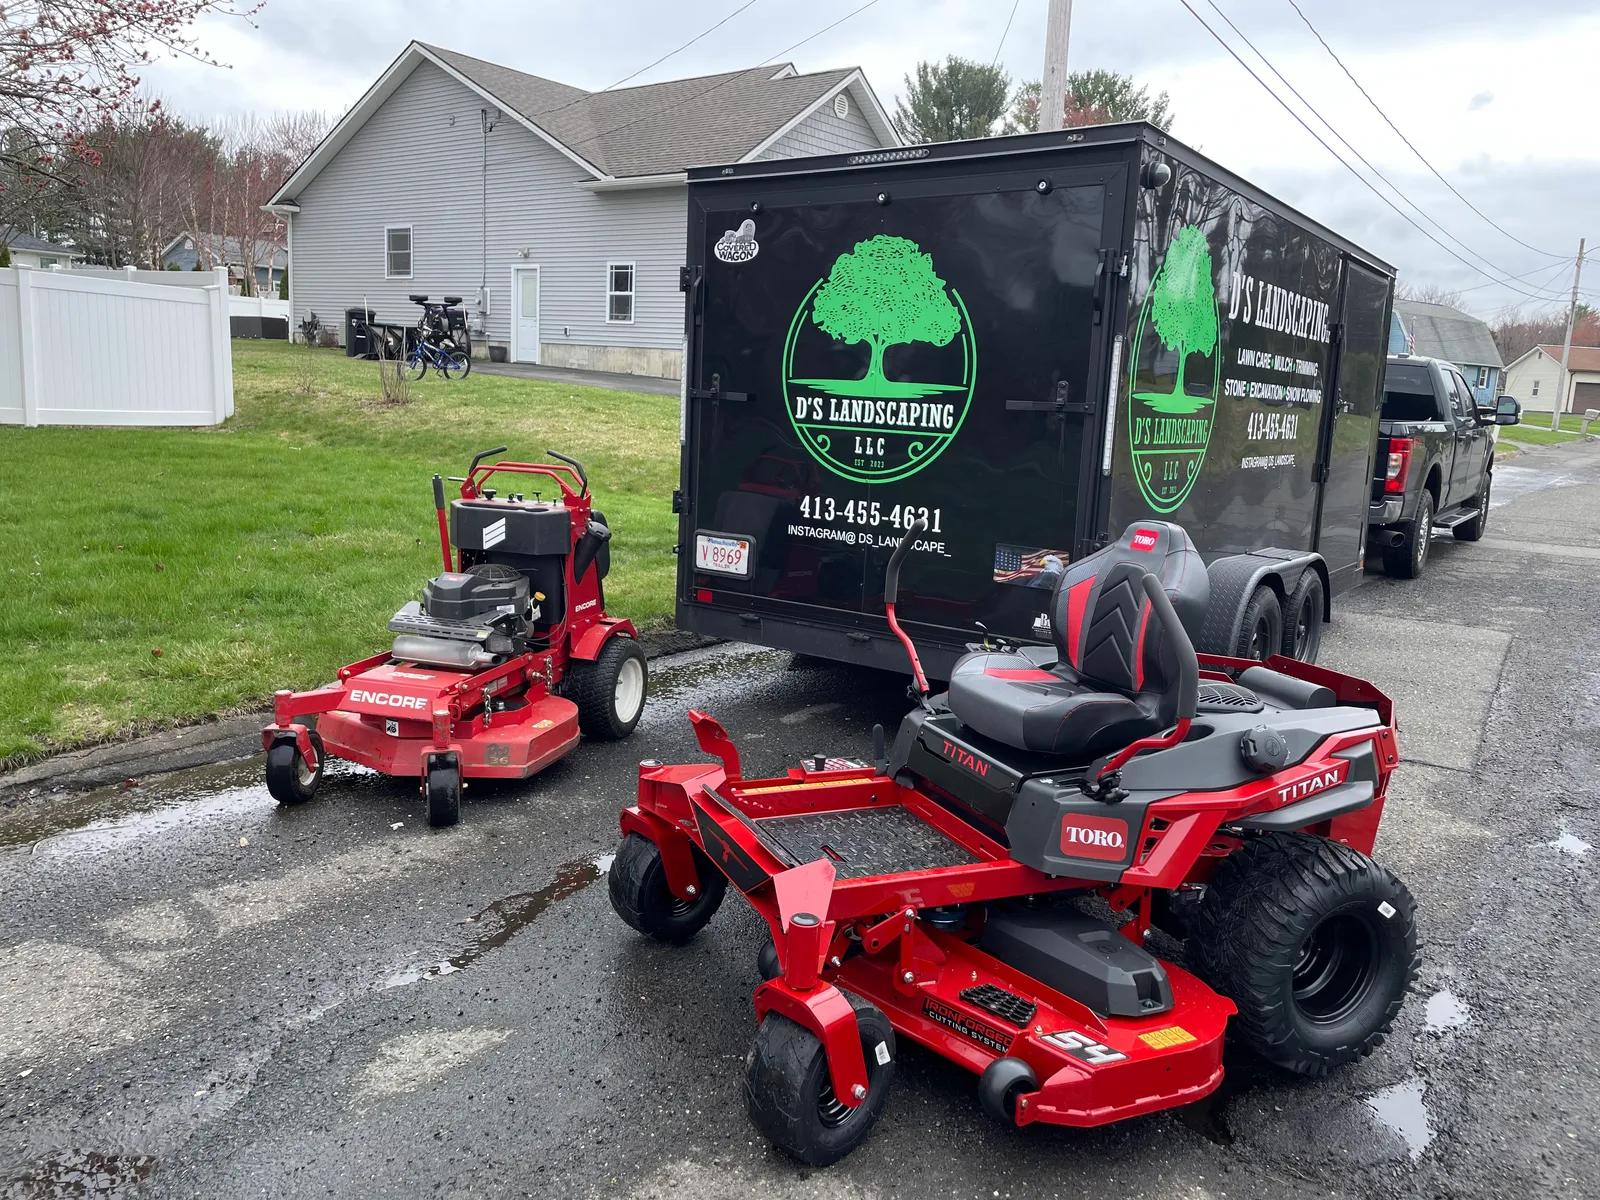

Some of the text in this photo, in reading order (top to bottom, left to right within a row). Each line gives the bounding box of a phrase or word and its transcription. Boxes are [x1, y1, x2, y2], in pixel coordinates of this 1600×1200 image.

[717, 242, 757, 251] COVERED
[719, 251, 754, 261] WAGON
[1228, 271, 1329, 343] D'S LANDSCAPING
[1237, 347, 1319, 377] LAWN CARE MULCH TRIMMING
[1224, 378, 1322, 404] STONE EXCAVATION SNOW PLOWING
[795, 396, 955, 429] D'S LANDSCAPING
[1133, 417, 1209, 445] D'S LANDSCAPING
[1247, 411, 1299, 440] 413-455-4631
[854, 436, 885, 456] LLC
[854, 459, 885, 469] EST 2023
[1163, 460, 1179, 481] LLC
[799, 495, 943, 534] 413-455-4631
[787, 524, 952, 557] INSTAGRAM@ DS_LANCAPE_
[1133, 534, 1156, 546] TORO
[702, 544, 742, 566] V 8969
[574, 598, 597, 613] ENCORE
[350, 689, 428, 711] ENCORE
[490, 756, 509, 765] 36
[943, 740, 989, 777] TITAN
[1278, 769, 1339, 802] TITAN
[1066, 826, 1123, 848] TORO
[929, 1010, 968, 1035] CUTTING
